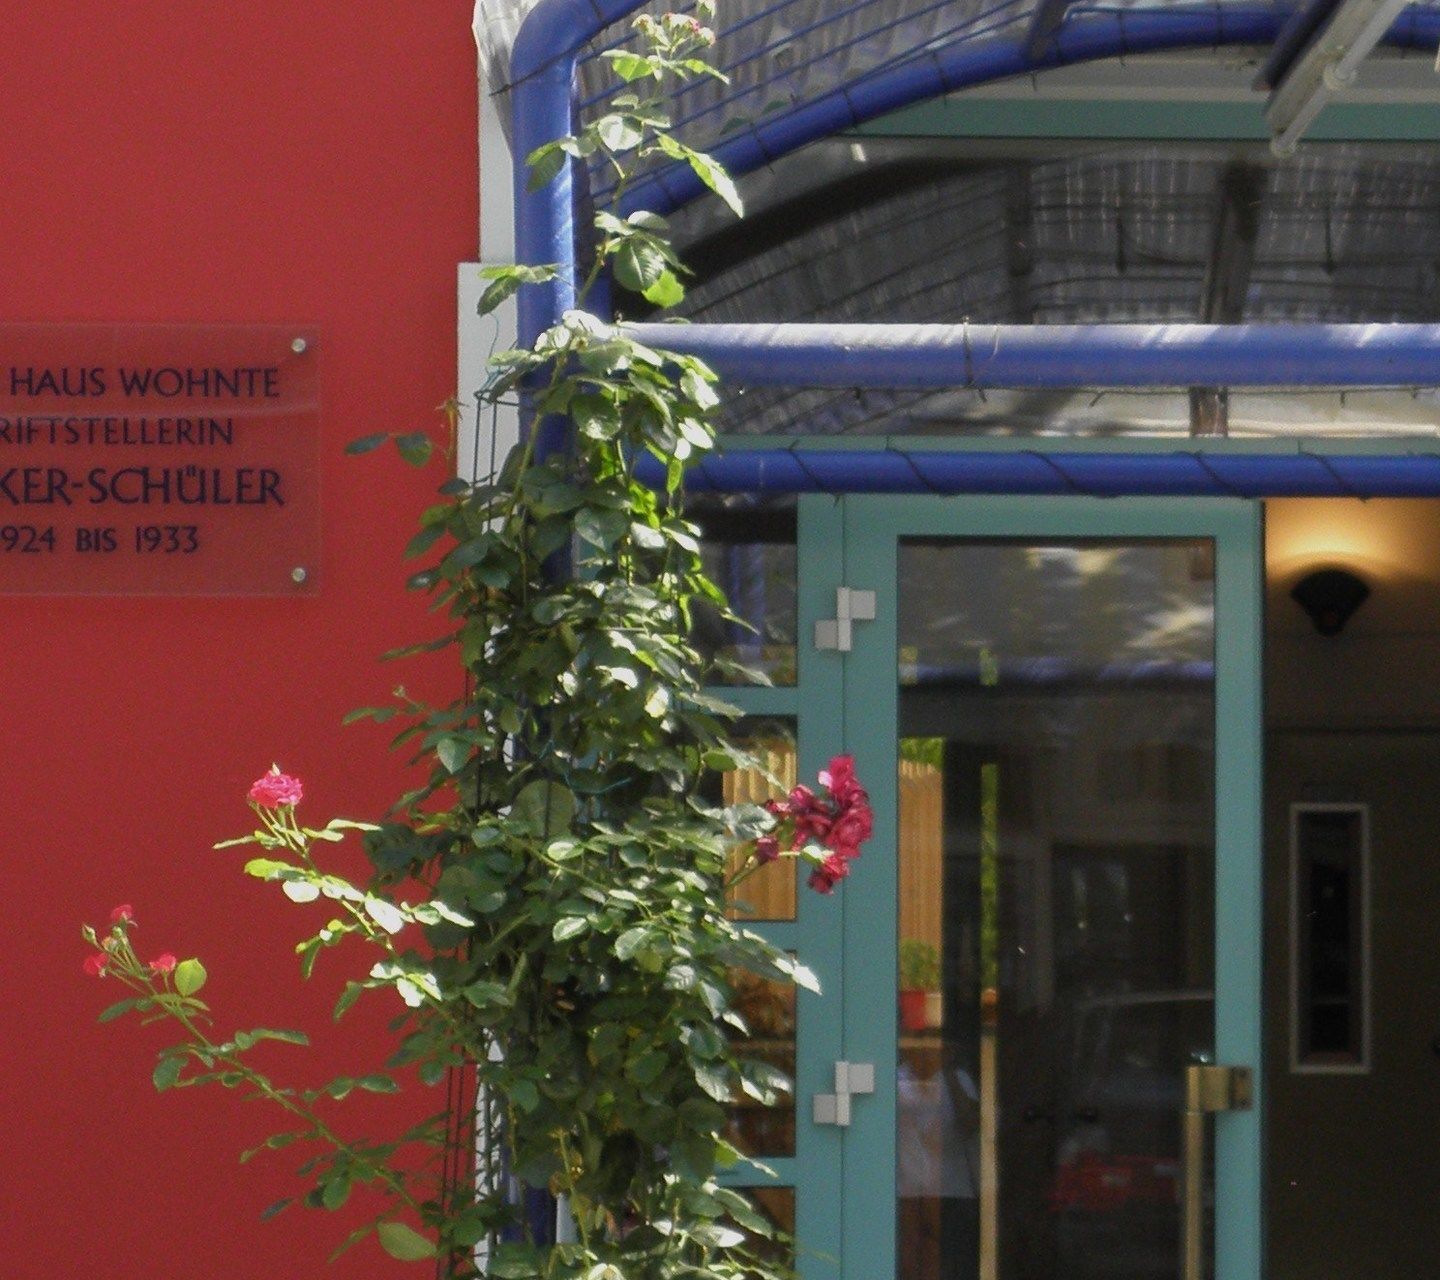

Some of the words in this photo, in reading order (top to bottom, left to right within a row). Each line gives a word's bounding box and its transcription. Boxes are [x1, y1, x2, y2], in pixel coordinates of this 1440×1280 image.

[9, 367, 107, 398] HAUS
[119, 367, 280, 398] WOHNTE
[75, 527, 118, 553] BIS
[135, 525, 200, 554] 1933
